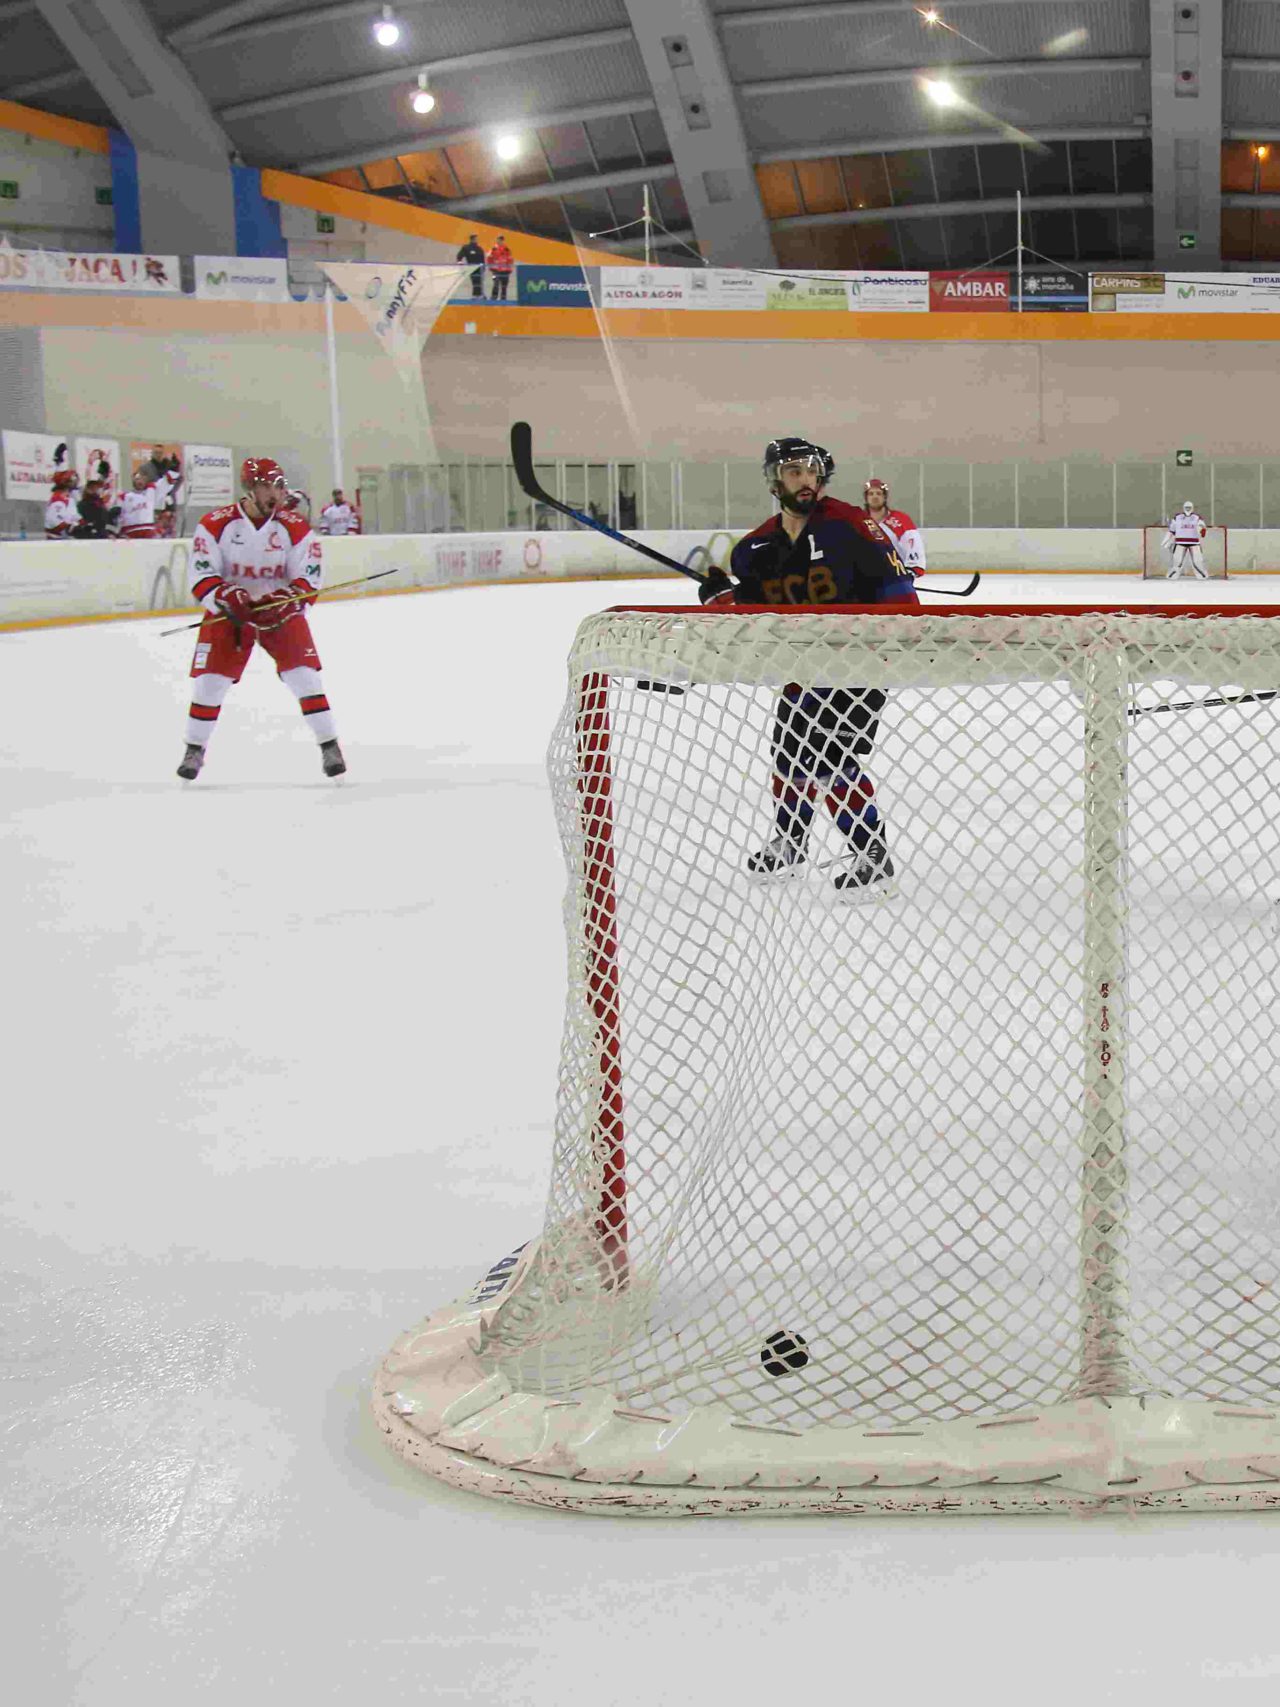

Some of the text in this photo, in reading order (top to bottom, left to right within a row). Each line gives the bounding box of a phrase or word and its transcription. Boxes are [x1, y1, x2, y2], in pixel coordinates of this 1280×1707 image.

[231, 274, 277, 285] movistar
[547, 281, 593, 292] movistar
[944, 281, 1008, 298] AMBAR
[1198, 287, 1239, 298] movistar
[231, 563, 285, 580] JACA
